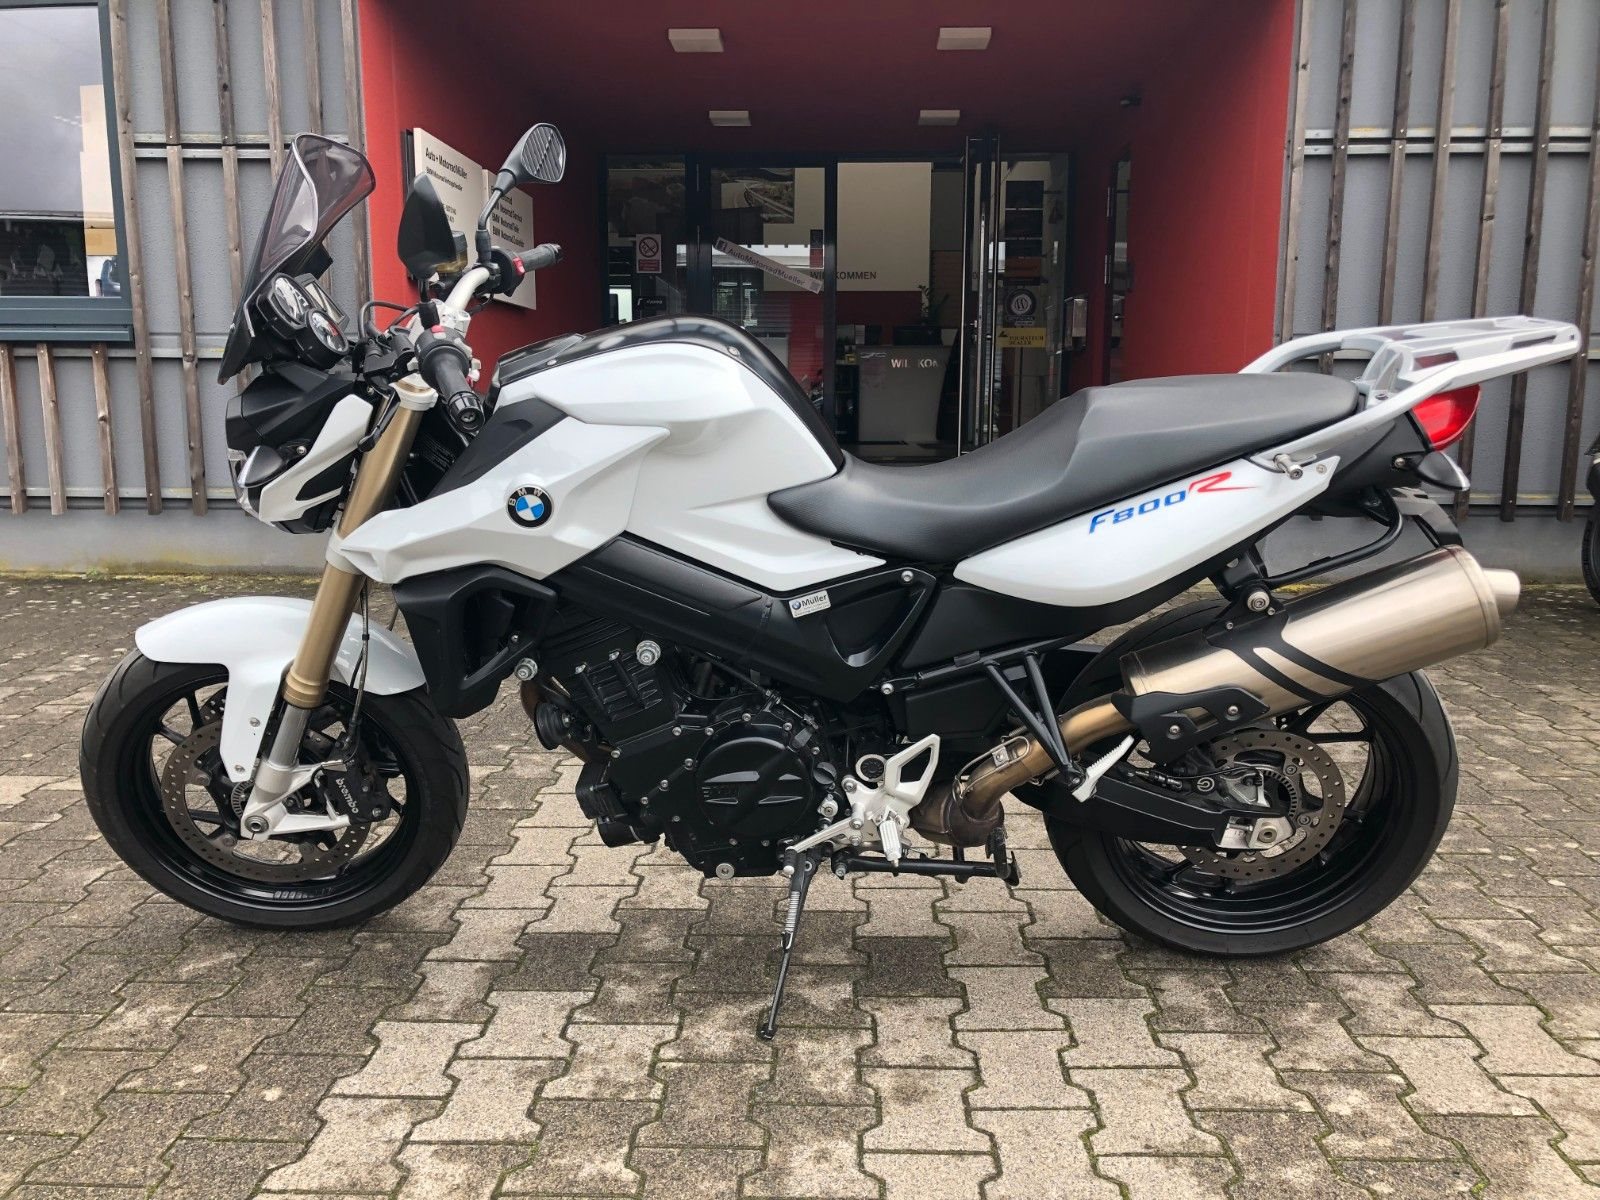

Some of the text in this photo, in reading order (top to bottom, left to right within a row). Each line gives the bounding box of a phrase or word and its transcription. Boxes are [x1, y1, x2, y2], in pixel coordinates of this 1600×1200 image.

[810, 271, 877, 280] WIKOMMEN
[509, 487, 543, 506] BMW
[335, 777, 359, 814] brembo
